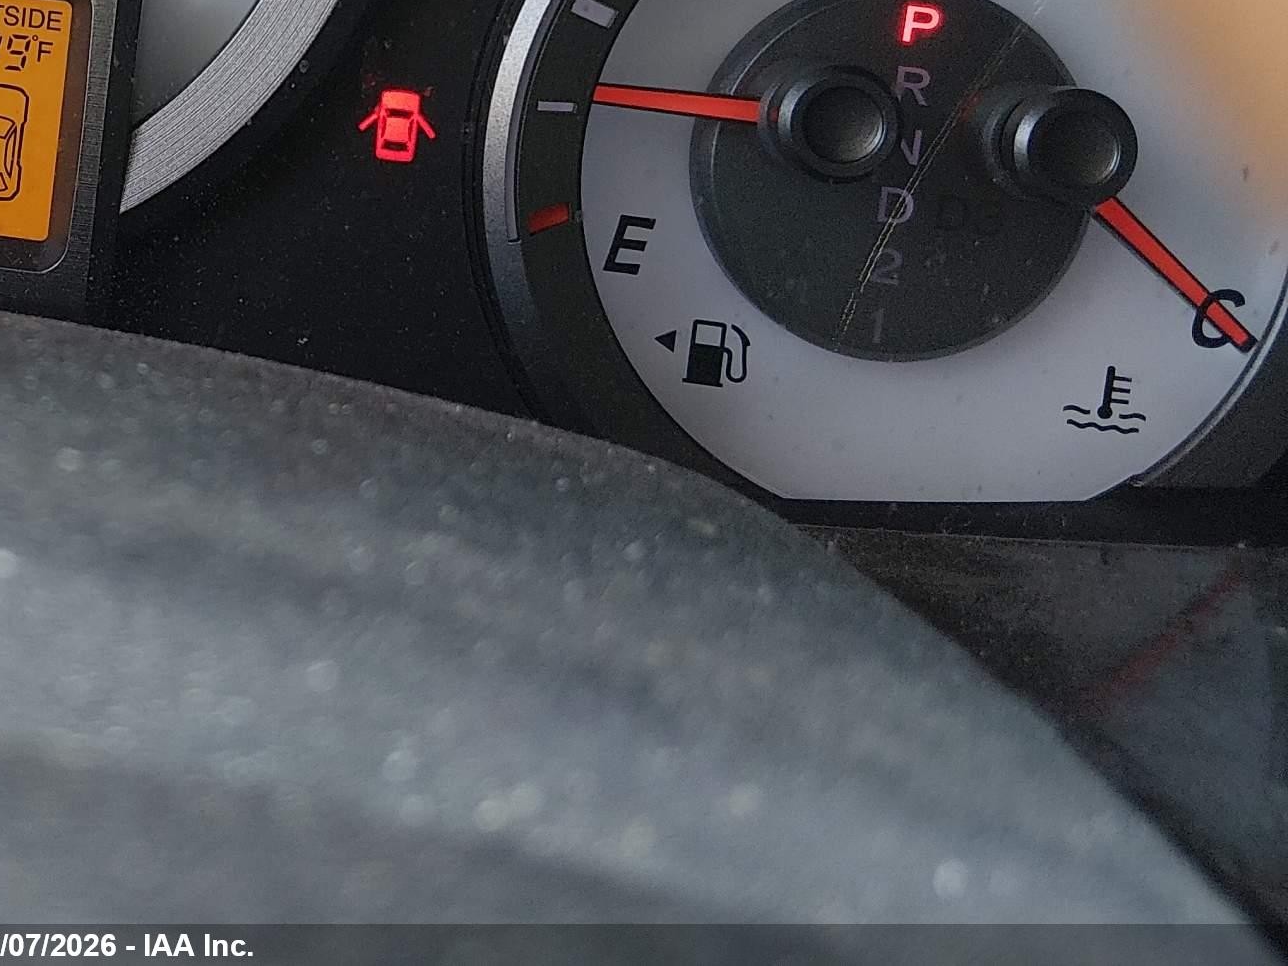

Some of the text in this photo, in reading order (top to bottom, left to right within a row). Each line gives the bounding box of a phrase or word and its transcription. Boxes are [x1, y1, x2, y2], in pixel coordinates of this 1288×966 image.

[901, 4, 940, 44] P
[894, 65, 931, 107] R
[876, 186, 913, 224] D
[603, 215, 657, 275] E
[1191, 289, 1246, 349] C
